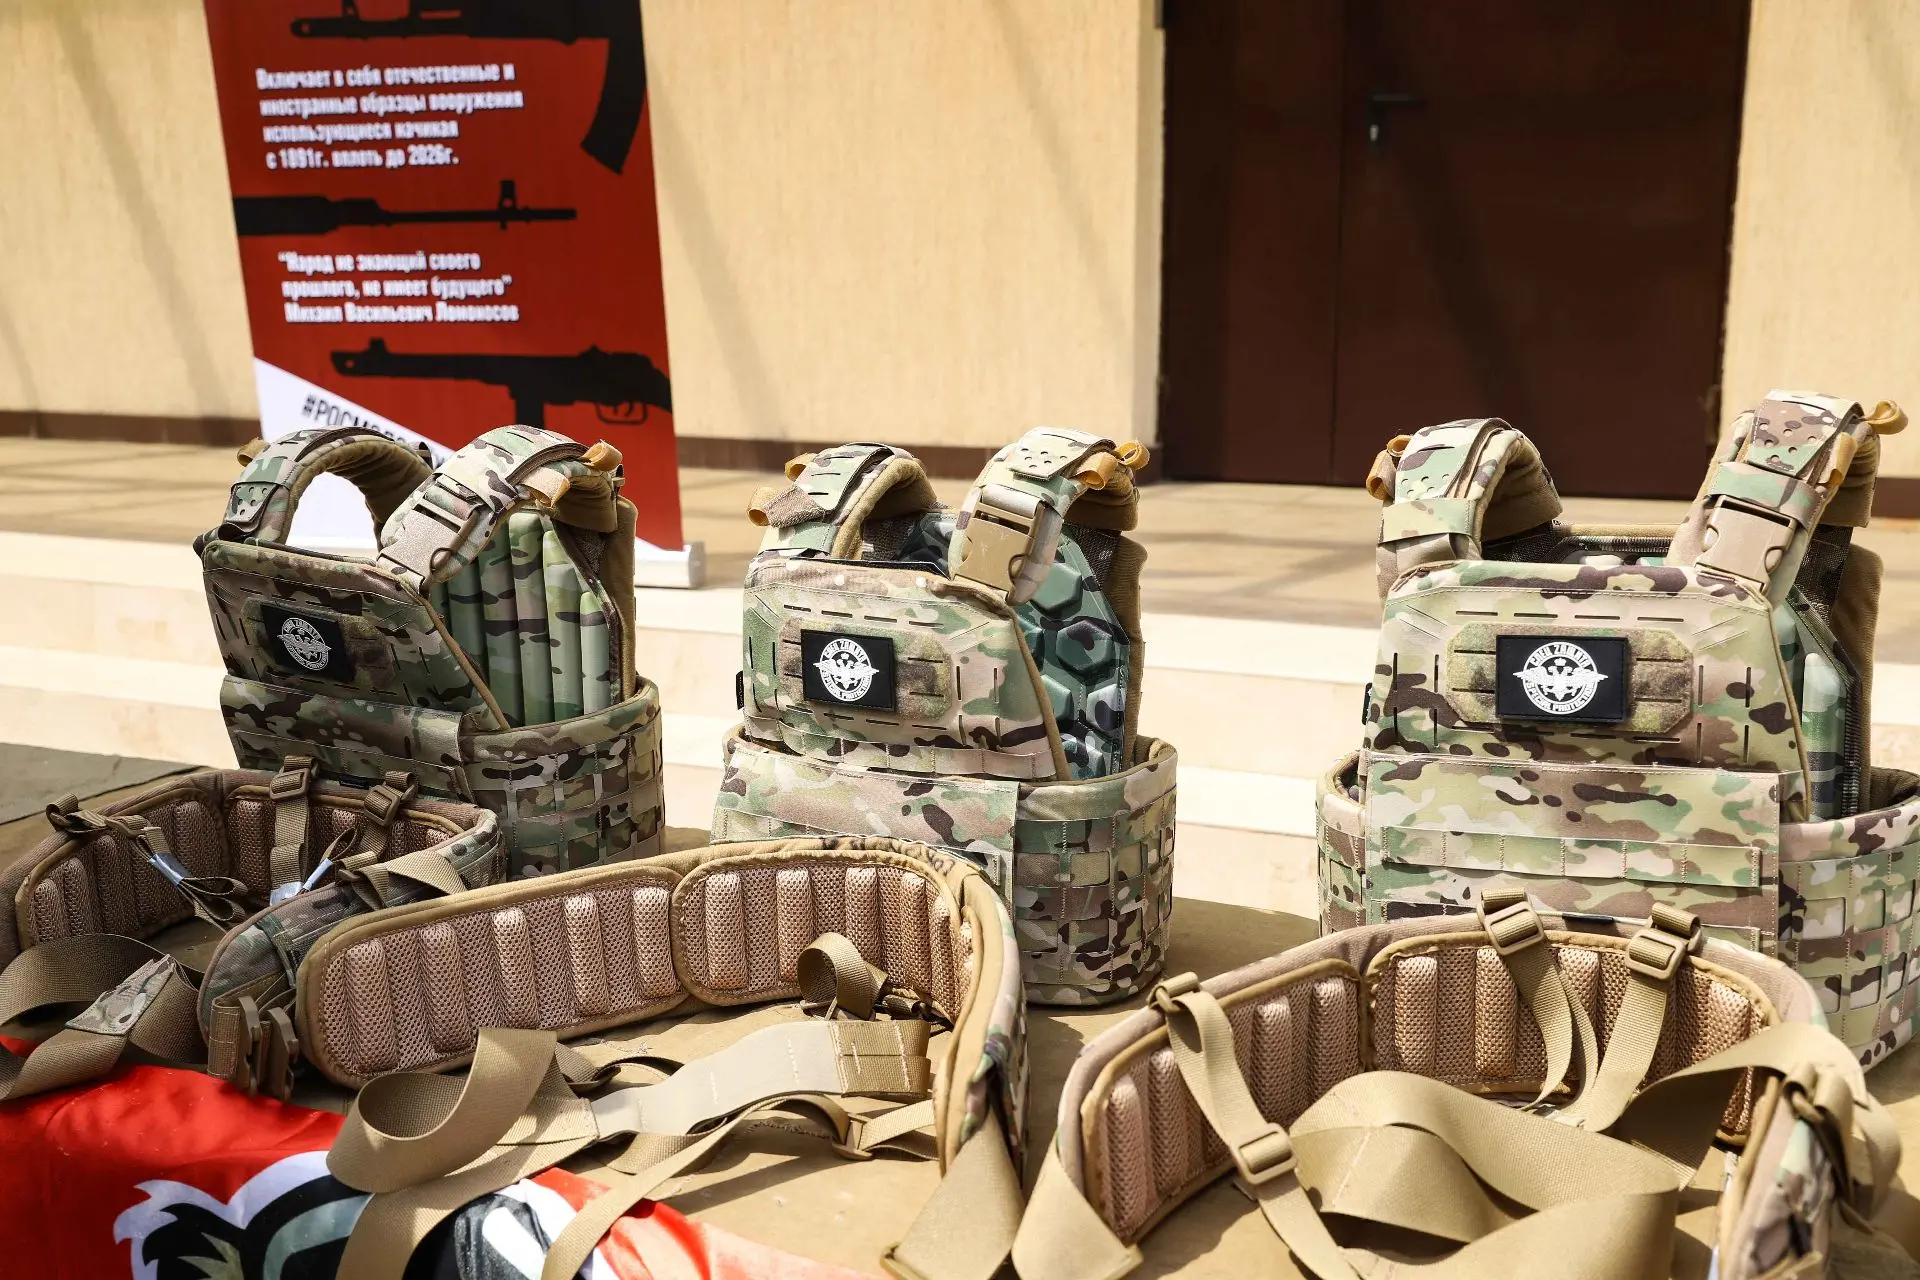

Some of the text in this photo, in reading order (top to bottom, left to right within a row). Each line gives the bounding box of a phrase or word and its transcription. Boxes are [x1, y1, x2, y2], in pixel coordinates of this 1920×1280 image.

[256, 63, 515, 90] Включает в себя отечественные и
[259, 91, 524, 120] иностранные образцы вооружения
[394, 120, 459, 139] начиная
[266, 152, 277, 169] с
[332, 150, 383, 168] вплоть
[385, 149, 405, 169] до
[408, 144, 460, 165] 2026г.
[335, 254, 355, 272] не
[356, 250, 427, 273] знающий
[429, 253, 481, 270] своего
[281, 280, 361, 301] прошлого,
[362, 280, 382, 297] не
[383, 280, 428, 296] имеет
[284, 301, 520, 322] Михаил Васильевич Ломоносов
[1529, 645, 1553, 667] СПЕЦ
[1525, 681, 1595, 712] SPECIAL PROTECTION
